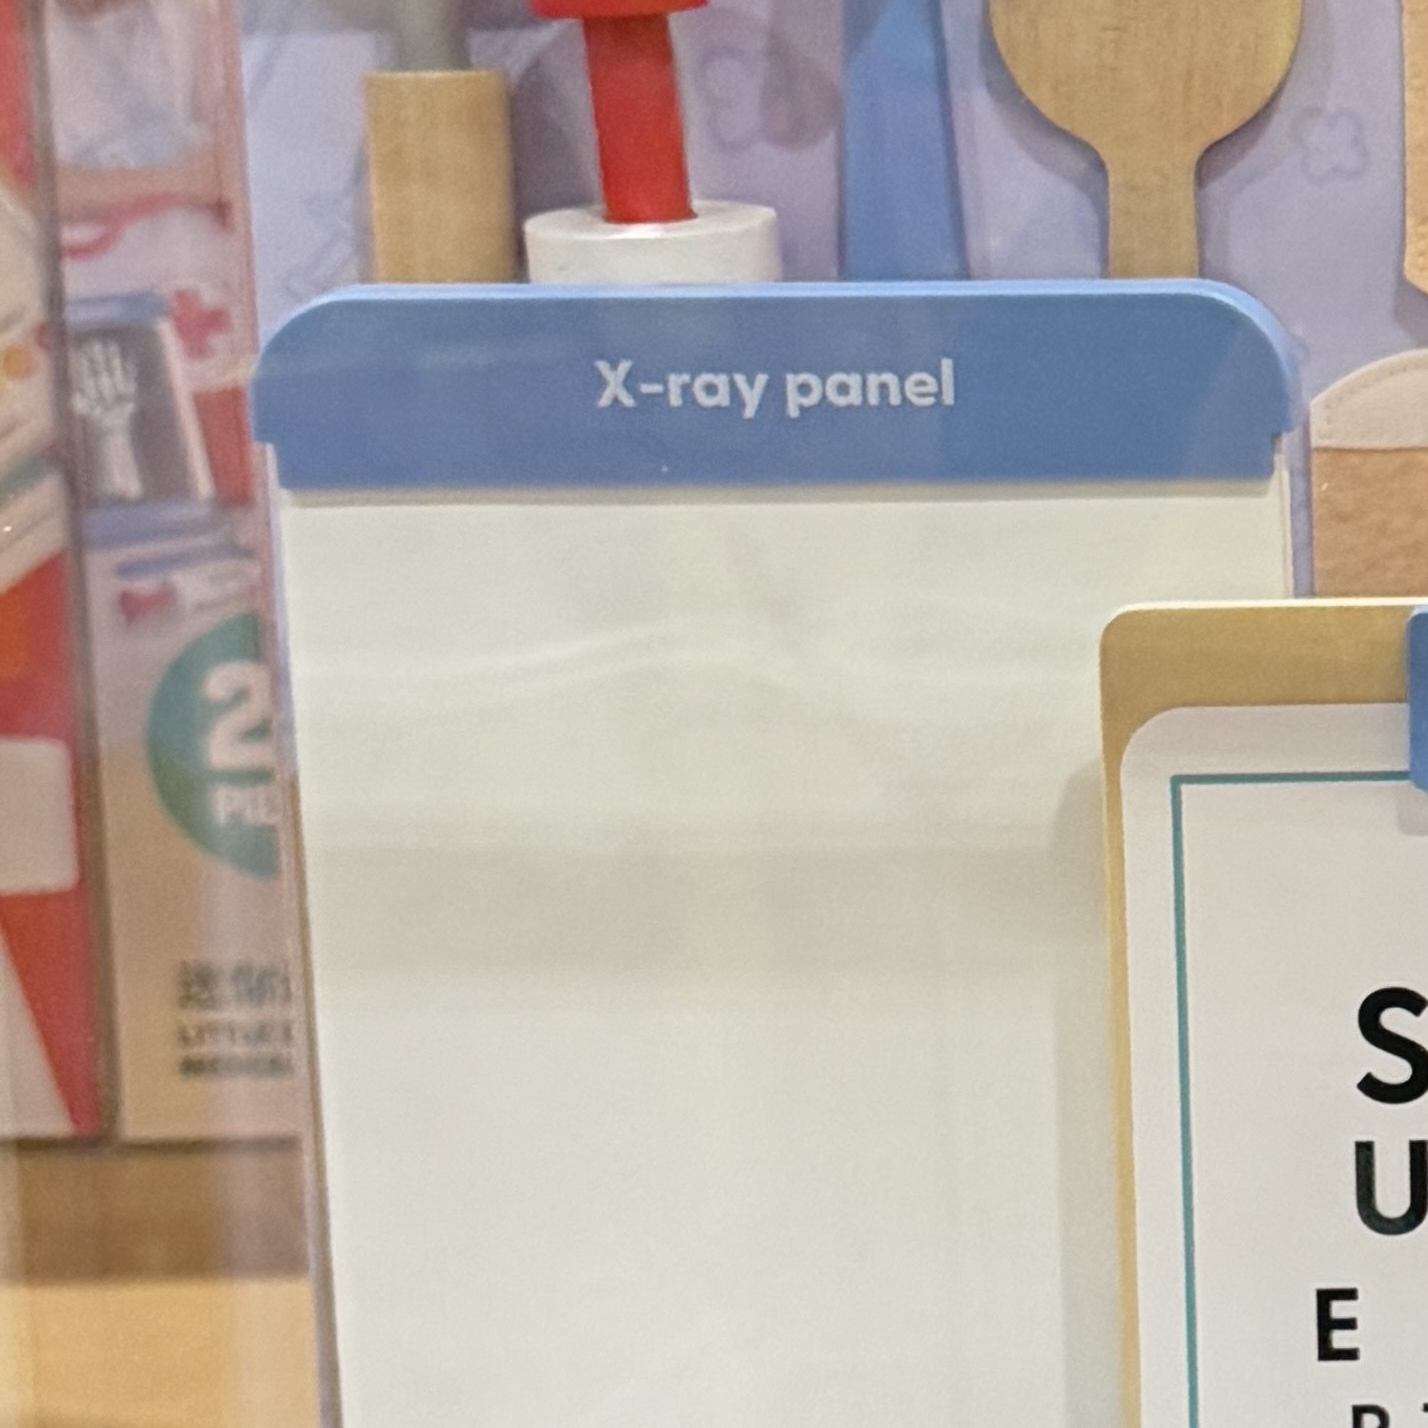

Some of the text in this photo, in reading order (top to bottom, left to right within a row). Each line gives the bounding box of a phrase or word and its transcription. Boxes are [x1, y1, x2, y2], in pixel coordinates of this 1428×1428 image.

[594, 357, 954, 419] X-ray panel
[1316, 1287, 1360, 1362] E
